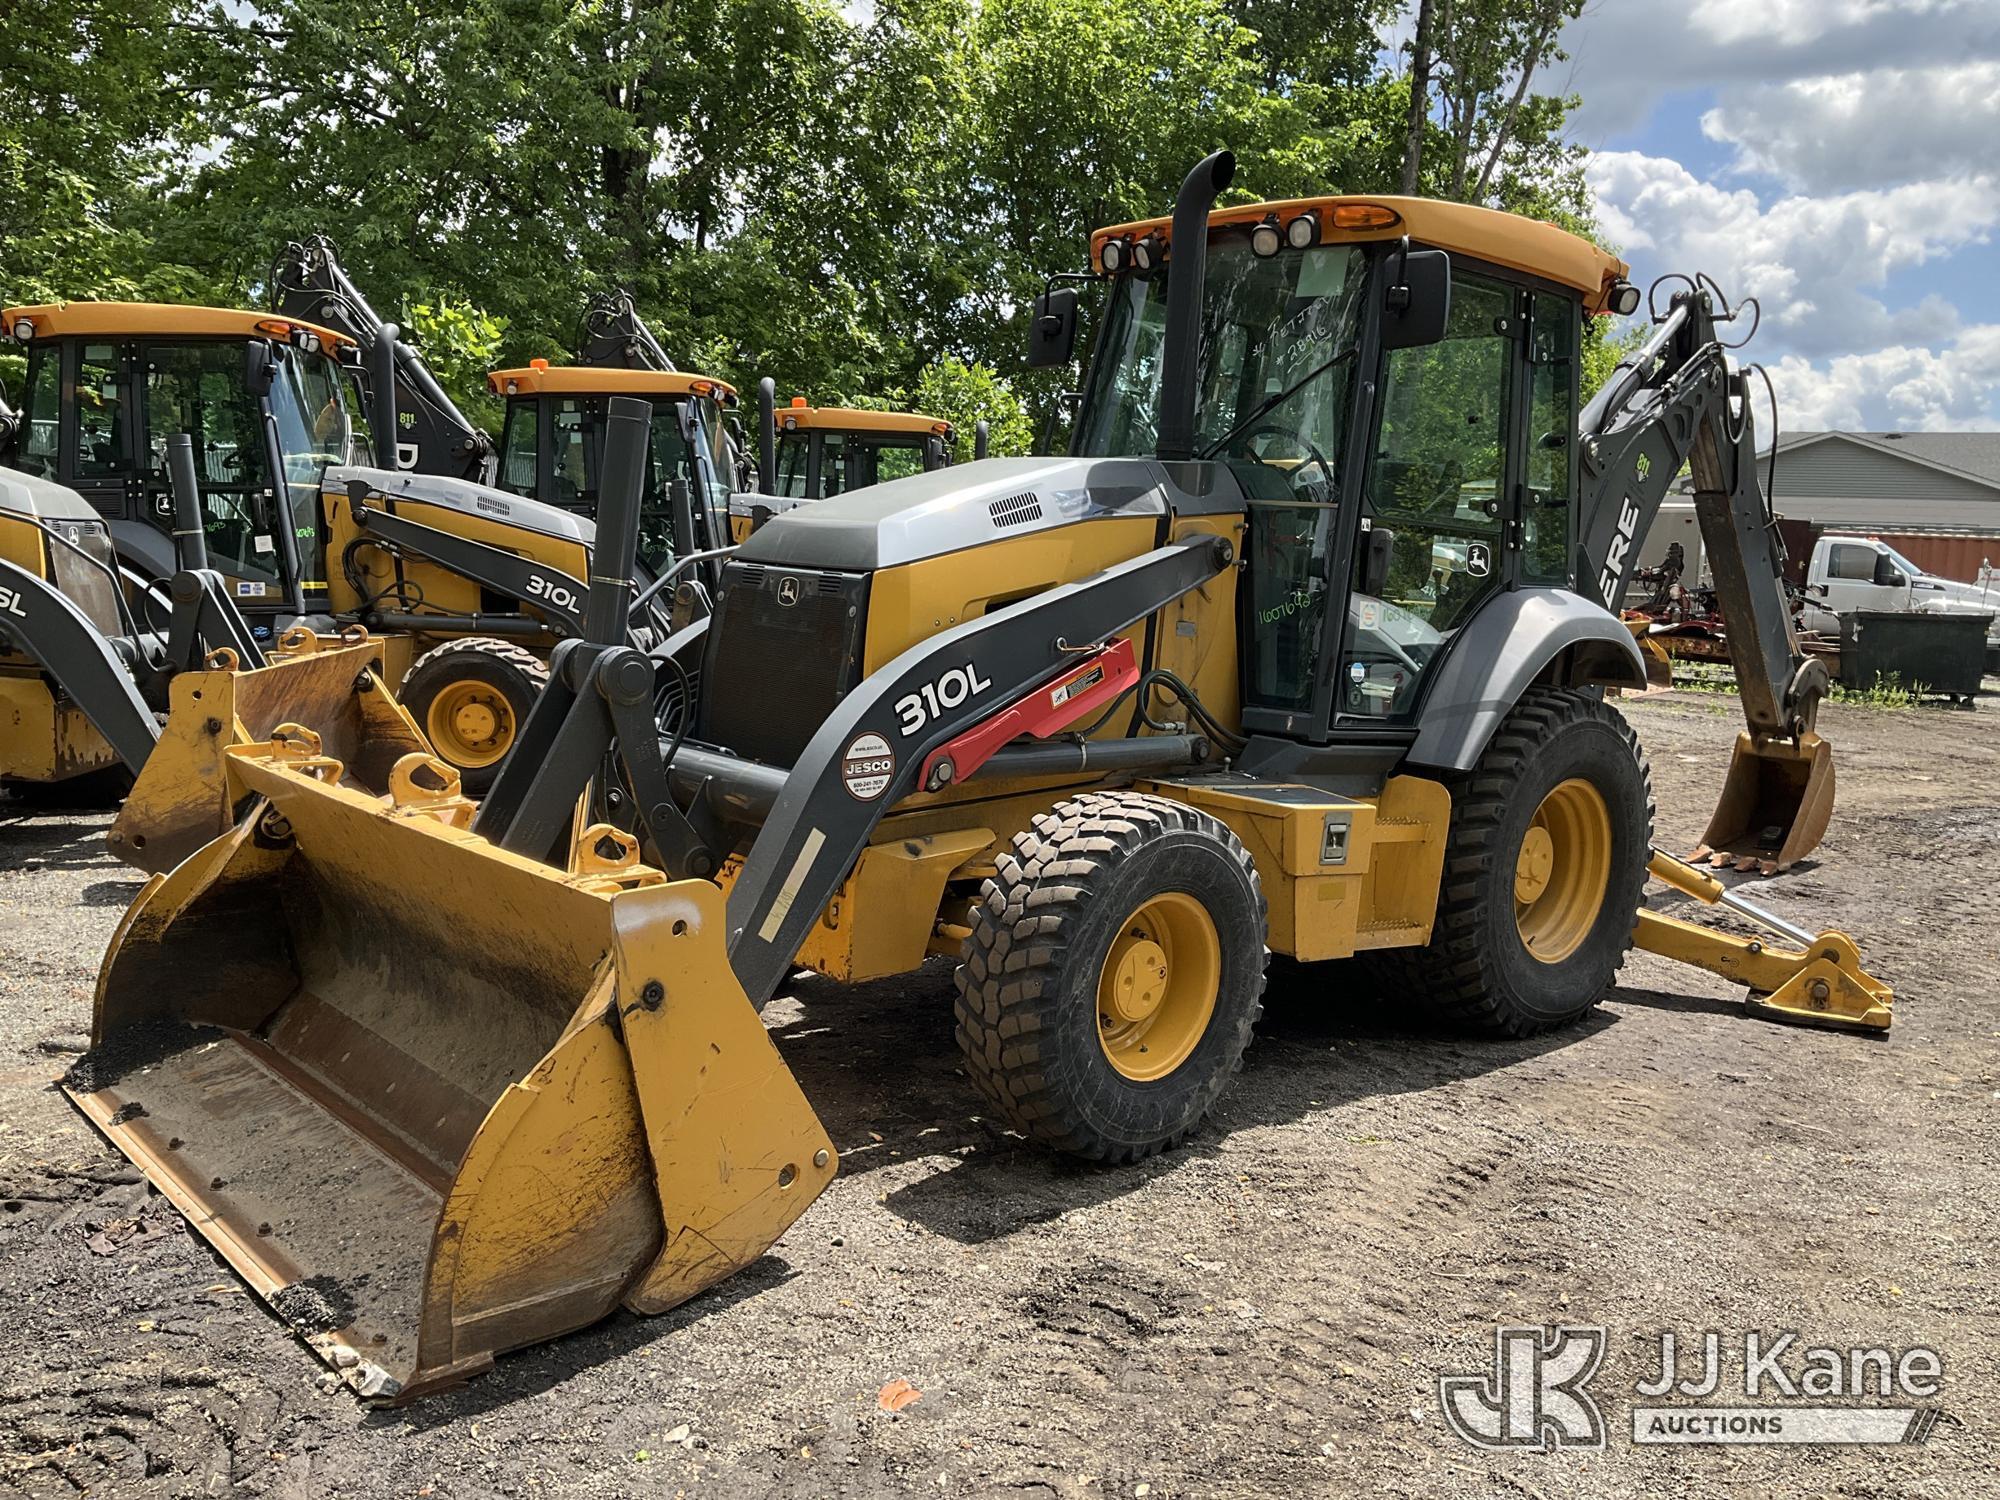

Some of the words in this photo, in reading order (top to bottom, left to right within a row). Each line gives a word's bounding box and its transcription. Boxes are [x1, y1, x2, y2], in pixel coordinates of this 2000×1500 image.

[525, 574, 580, 614] 310L
[894, 663, 992, 736] 310L
[846, 760, 891, 775] JESCO
